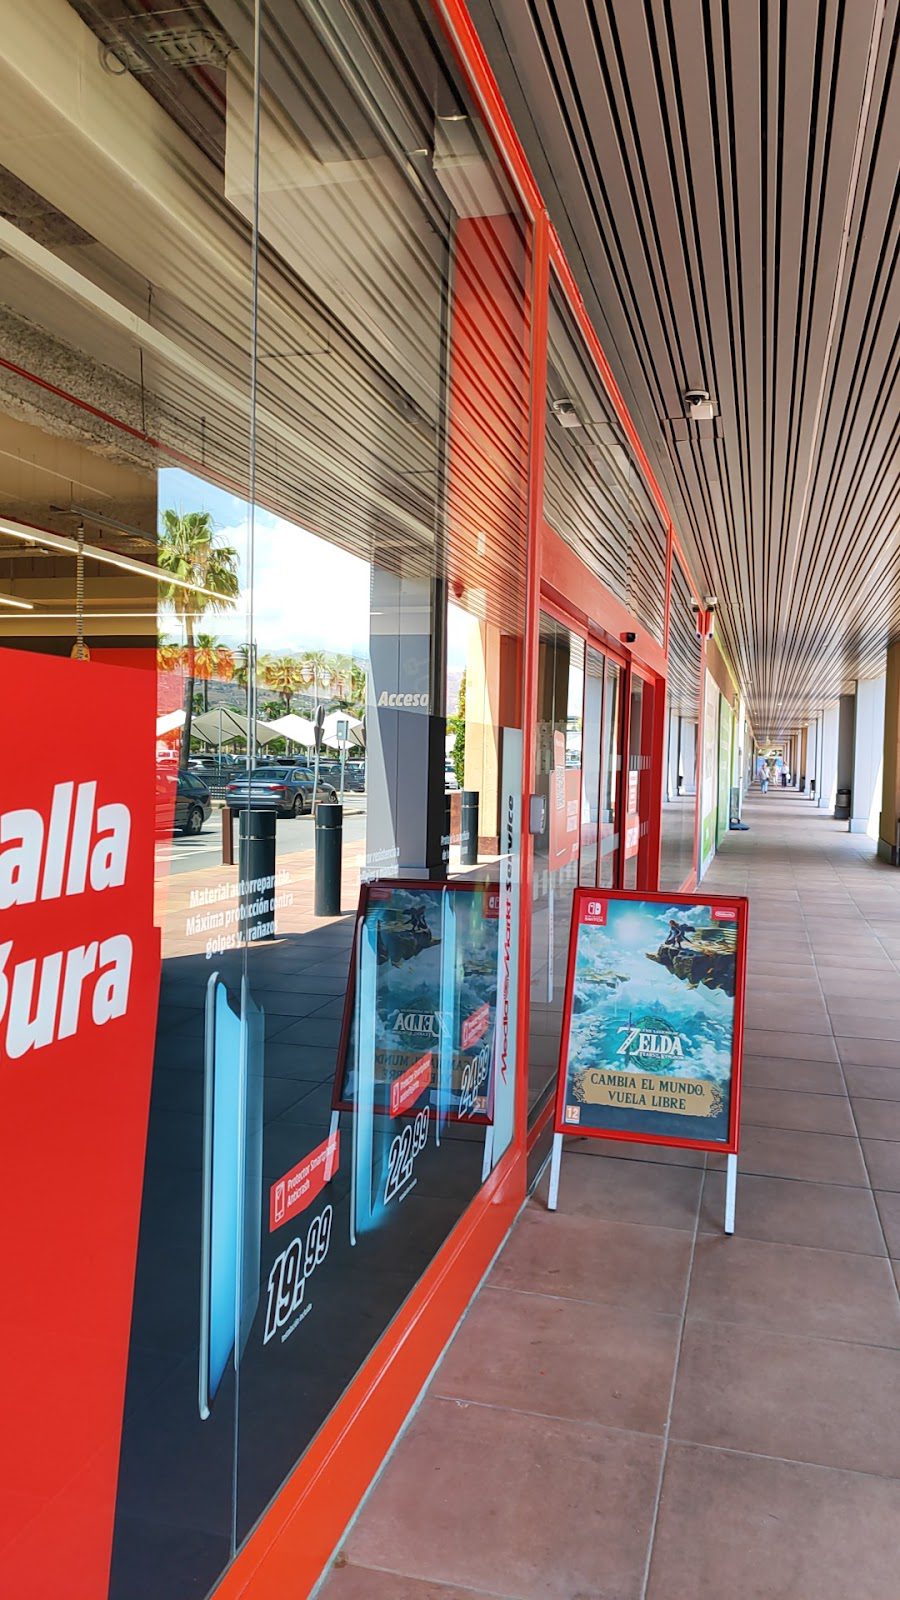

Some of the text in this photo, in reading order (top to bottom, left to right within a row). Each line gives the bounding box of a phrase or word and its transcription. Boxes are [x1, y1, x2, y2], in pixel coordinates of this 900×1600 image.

[378, 691, 430, 707] Acceso
[505, 794, 514, 893] Service
[189, 882, 230, 908] Material
[185, 910, 225, 936] Máxima
[205, 932, 236, 960] golpes
[0, 933, 133, 1060] ura
[617, 1027, 684, 1057] ZELDA
[590, 1072, 637, 1089] CAMBIA
[641, 1078, 655, 1091] EL
[566, 1107, 580, 1119] 12
[608, 1090, 687, 1111] VUELA LIBRE
